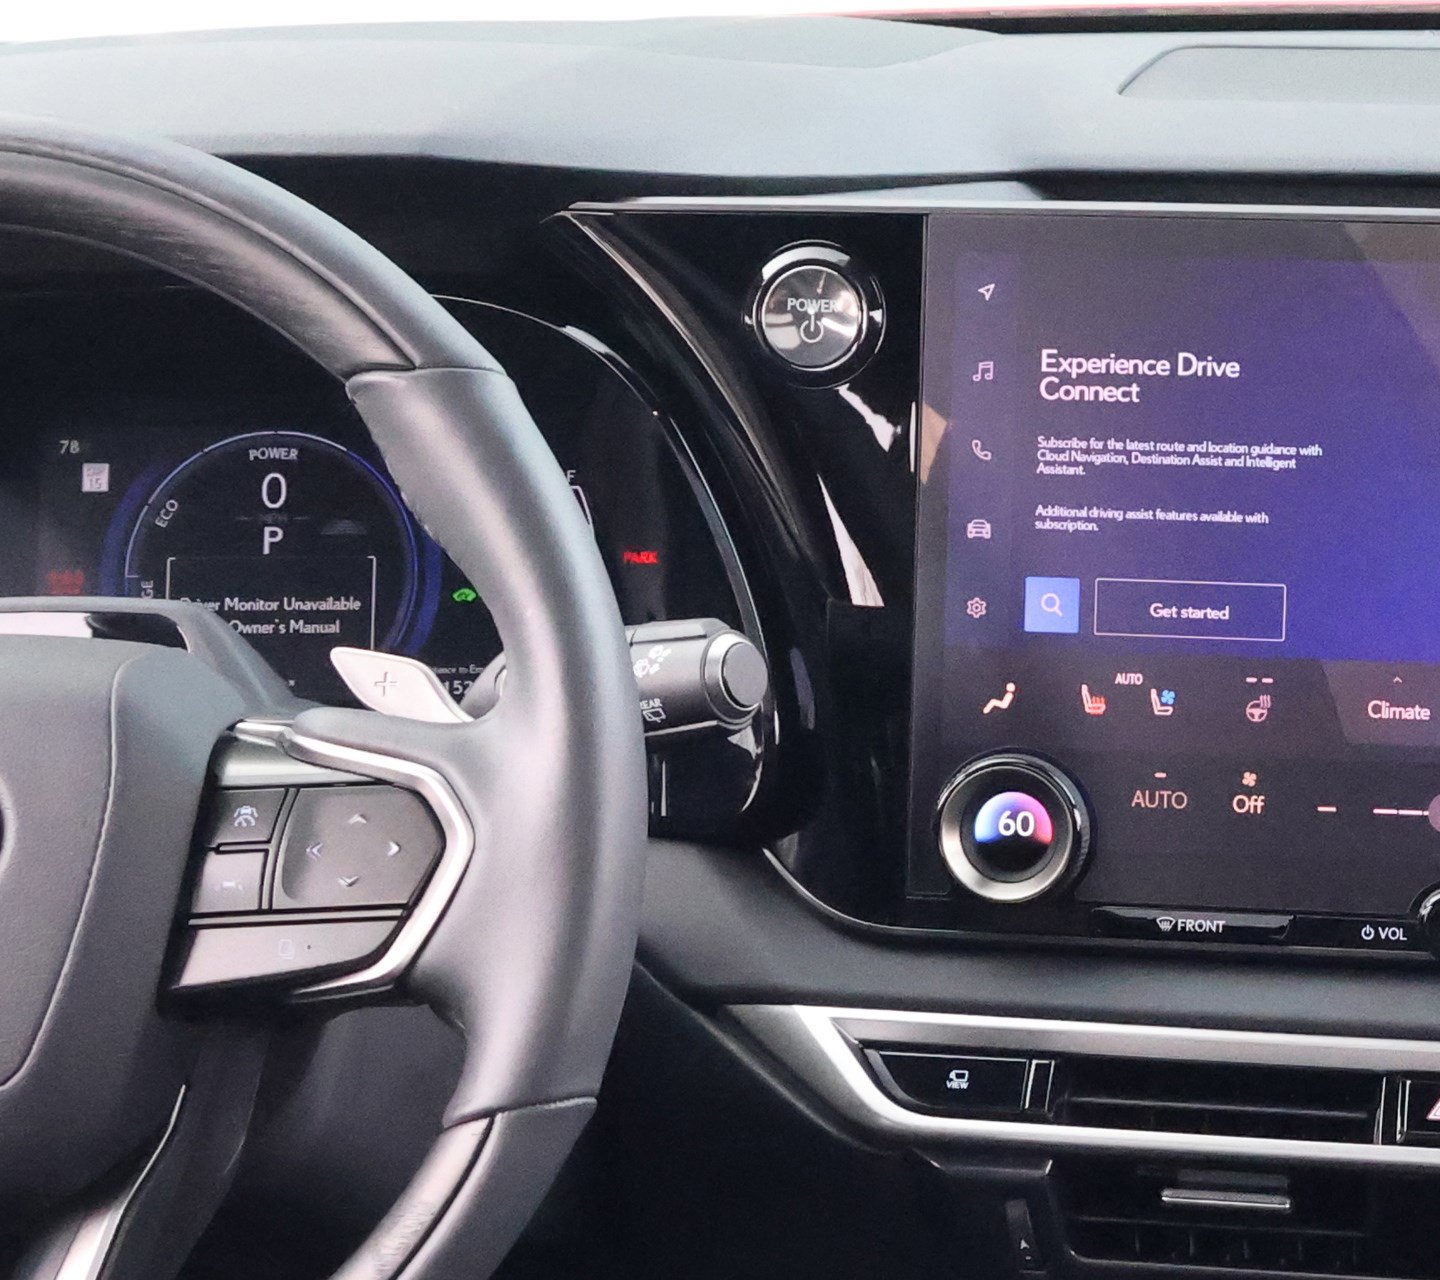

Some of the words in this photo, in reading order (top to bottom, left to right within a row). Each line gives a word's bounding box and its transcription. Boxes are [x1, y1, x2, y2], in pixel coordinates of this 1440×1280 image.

[786, 297, 844, 313] POWER
[1040, 348, 1171, 379] Experience
[1176, 352, 1241, 378] Drive
[1039, 376, 1141, 403] Connect
[59, 440, 81, 454] 78
[249, 448, 299, 461] POWER
[1037, 435, 1088, 450] Subscribe
[1089, 437, 1105, 450] for
[1106, 437, 1124, 451] the
[1125, 439, 1156, 452] latest
[1156, 441, 1186, 453] route
[1186, 440, 1208, 454] and
[1208, 442, 1249, 455] location
[1250, 443, 1298, 457] guidance
[1299, 444, 1323, 457] with
[1036, 462, 1086, 476] Assistant.
[1037, 449, 1070, 462] Cloud
[1070, 450, 1129, 466] Navigation,
[1131, 452, 1191, 467] Destination
[1191, 455, 1224, 468] Assist
[1224, 455, 1246, 468] and
[1246, 456, 1297, 471] Intelligent
[566, 469, 577, 483] F
[261, 472, 287, 509] 0
[154, 499, 179, 528] ECO
[1035, 505, 1088, 519] Additional
[1088, 507, 1124, 522] driving
[1125, 509, 1154, 521] assist
[1155, 509, 1199, 522] features
[1199, 510, 1244, 524] available
[1244, 512, 1270, 524] with
[1035, 519, 1099, 533] subscription.
[262, 526, 284, 555] P
[224, 598, 280, 612] Monitor
[283, 597, 362, 612] Unavailable
[1149, 602, 1178, 618] Get
[1180, 606, 1230, 620] started
[289, 620, 340, 634] Manual
[1114, 673, 1143, 686] AUTO
[1367, 700, 1431, 721] Climate
[1131, 790, 1188, 810] AUTO
[1232, 794, 1265, 815] Off
[997, 811, 1036, 838] 60
[1176, 919, 1226, 934] FRONT
[1378, 926, 1408, 941] VOL
[946, 1080, 970, 1090] VIEW
